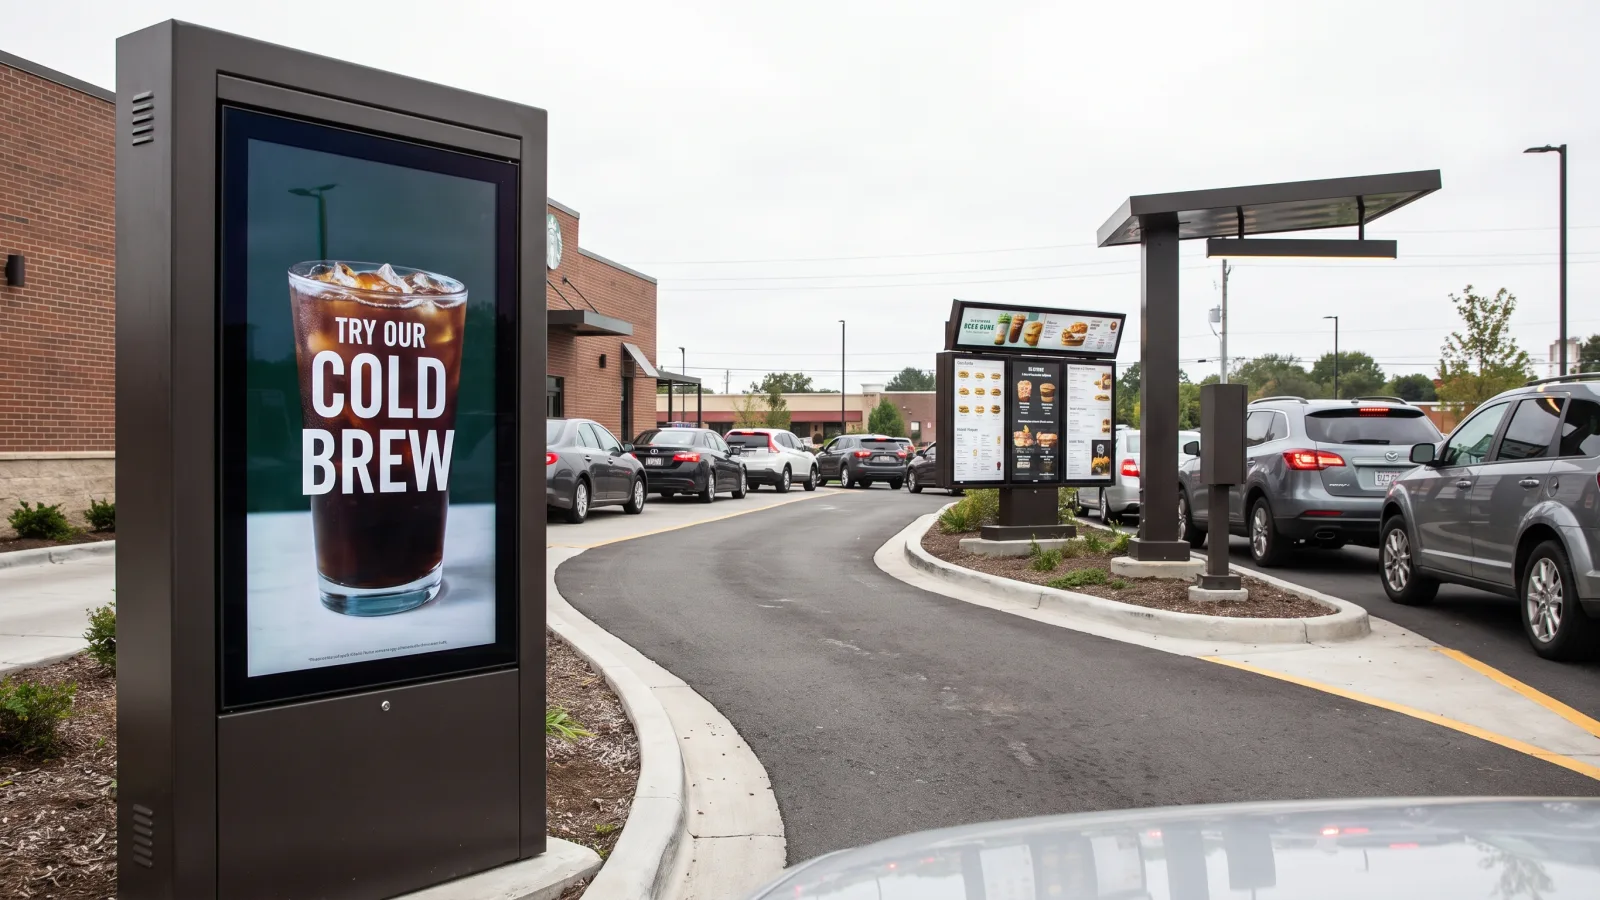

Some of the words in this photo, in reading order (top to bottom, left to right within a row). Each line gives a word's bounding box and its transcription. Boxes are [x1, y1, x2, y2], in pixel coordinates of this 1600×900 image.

[335, 317, 376, 345] TRY
[384, 321, 426, 348] OUR
[312, 351, 446, 418] COLD
[302, 429, 455, 495] BREW
